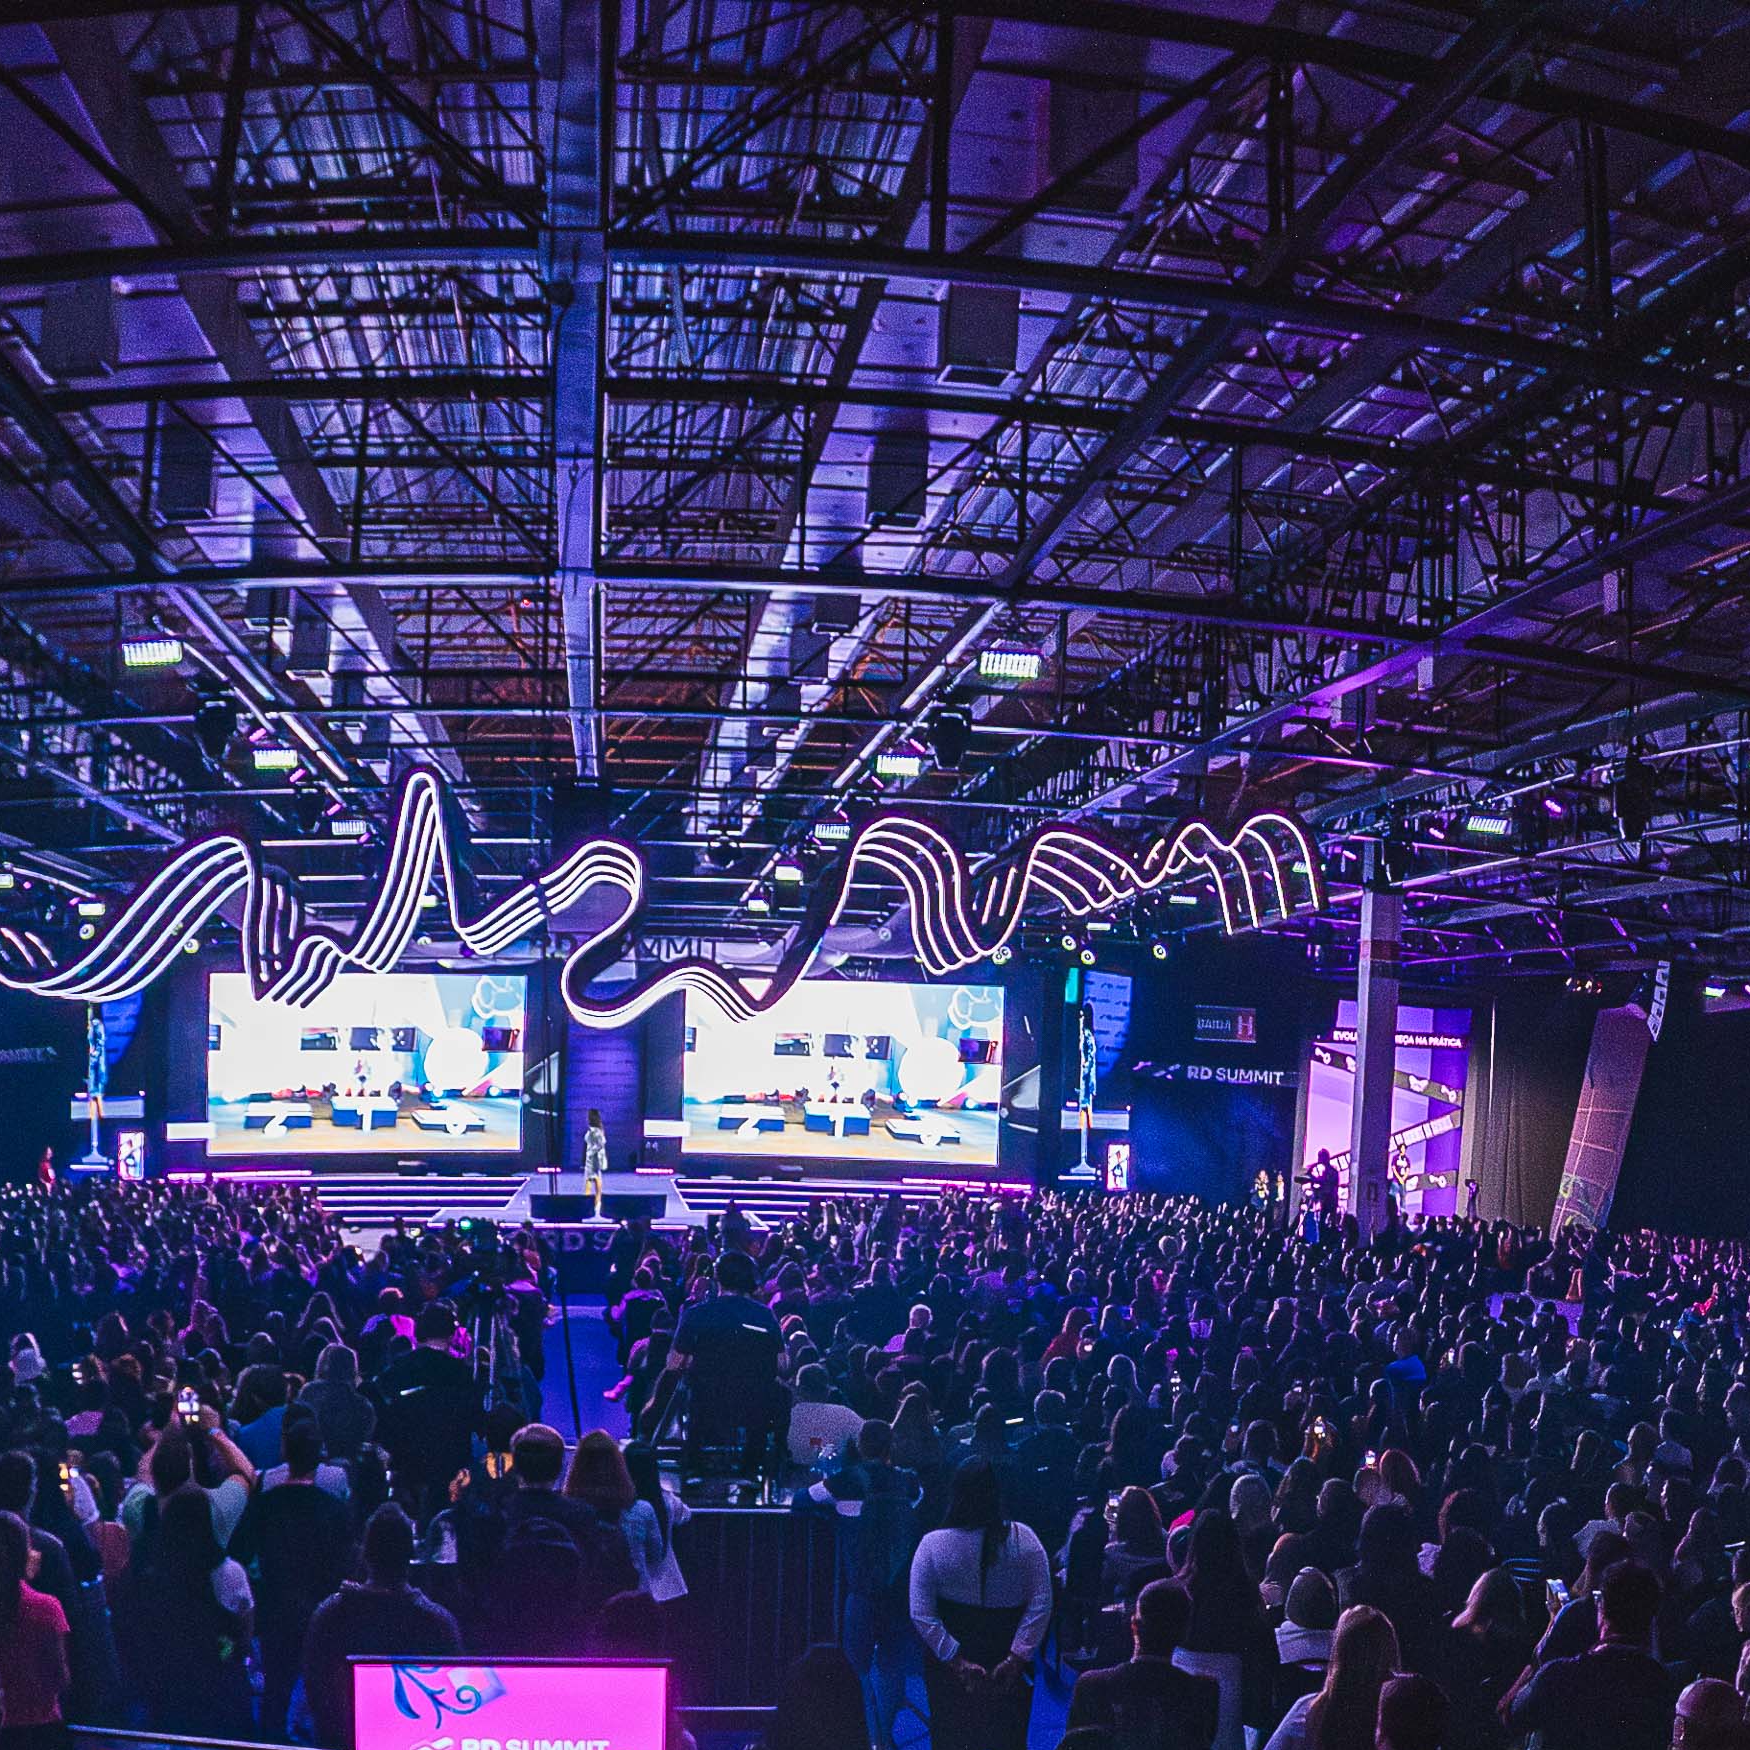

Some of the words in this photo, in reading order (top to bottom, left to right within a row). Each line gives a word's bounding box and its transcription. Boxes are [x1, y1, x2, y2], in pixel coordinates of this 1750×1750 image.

[1332, 1030, 1358, 1042] EVOLU
[1415, 1035, 1428, 1046] NA
[1186, 1064, 1213, 1081] RD
[1215, 1067, 1285, 1086] SUMMIT
